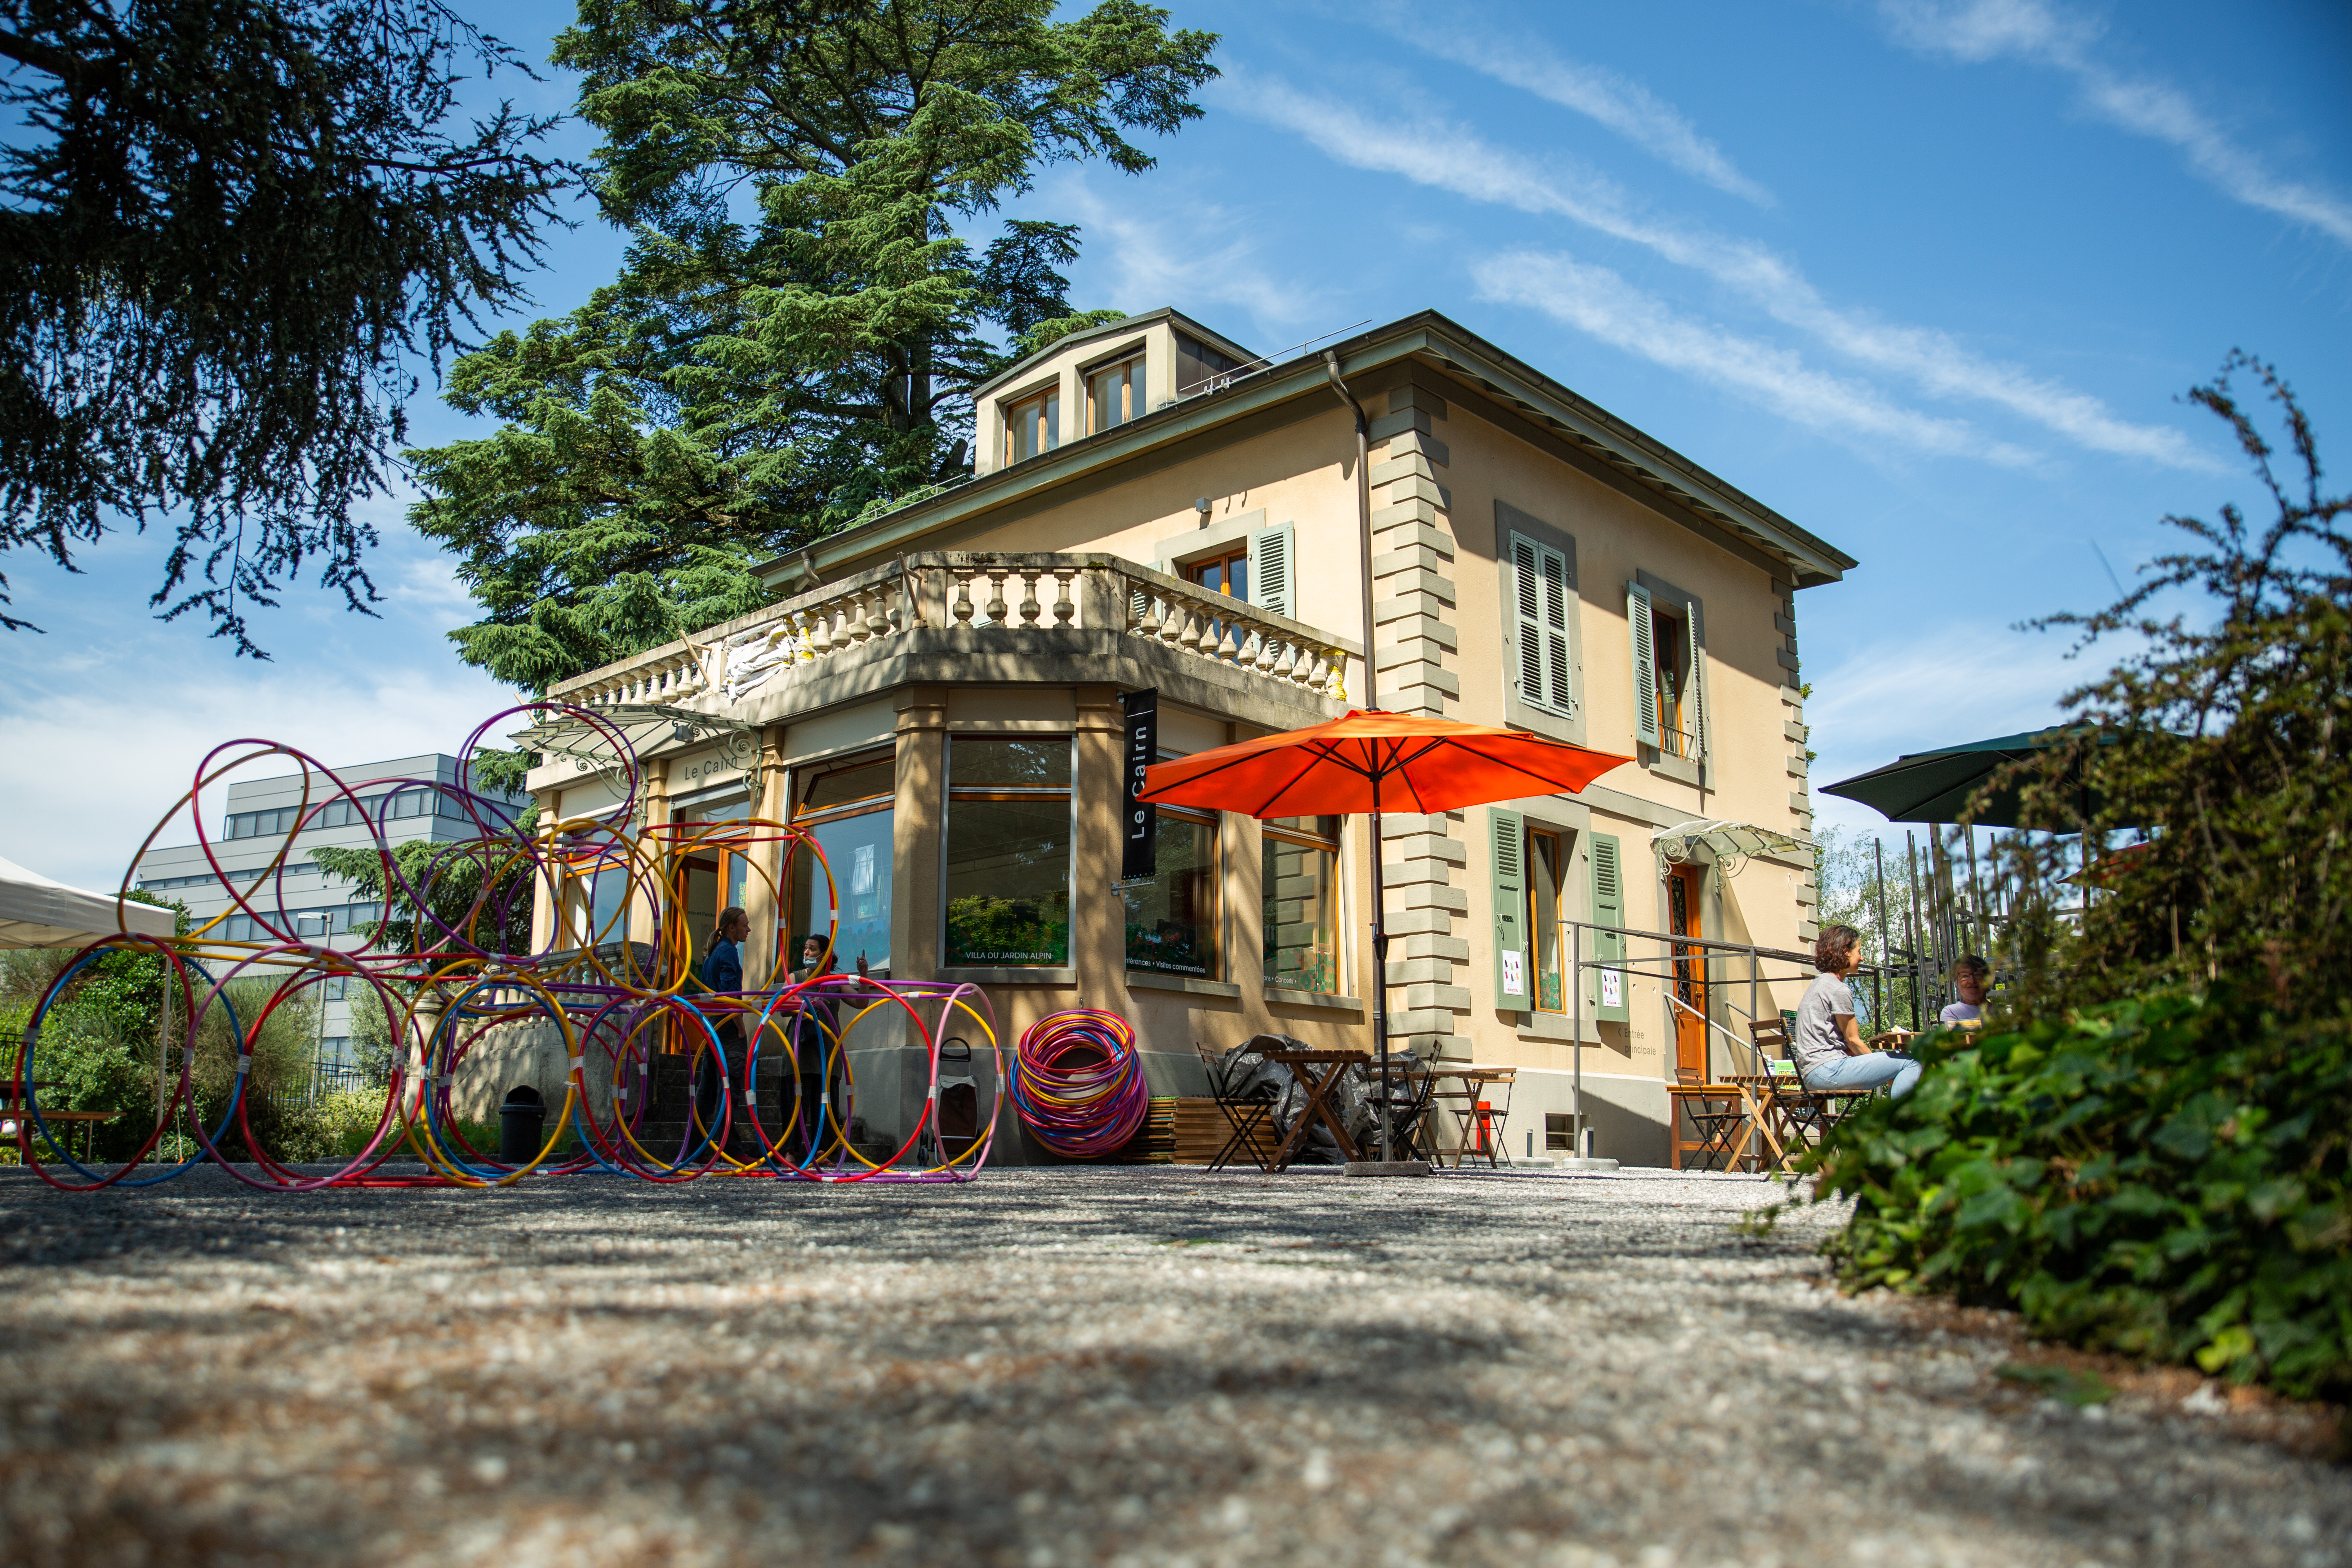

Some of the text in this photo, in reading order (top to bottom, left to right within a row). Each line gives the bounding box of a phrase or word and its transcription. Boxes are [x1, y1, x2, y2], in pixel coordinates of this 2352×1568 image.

[685, 756, 737, 780] Le Cairn
[1132, 726, 1146, 839] Le Cairn
[1156, 961, 1172, 969] Visites
[1172, 964, 1205, 973] commentées
[1624, 1028, 1644, 1039] Entrée
[1625, 1044, 1656, 1056] principale
